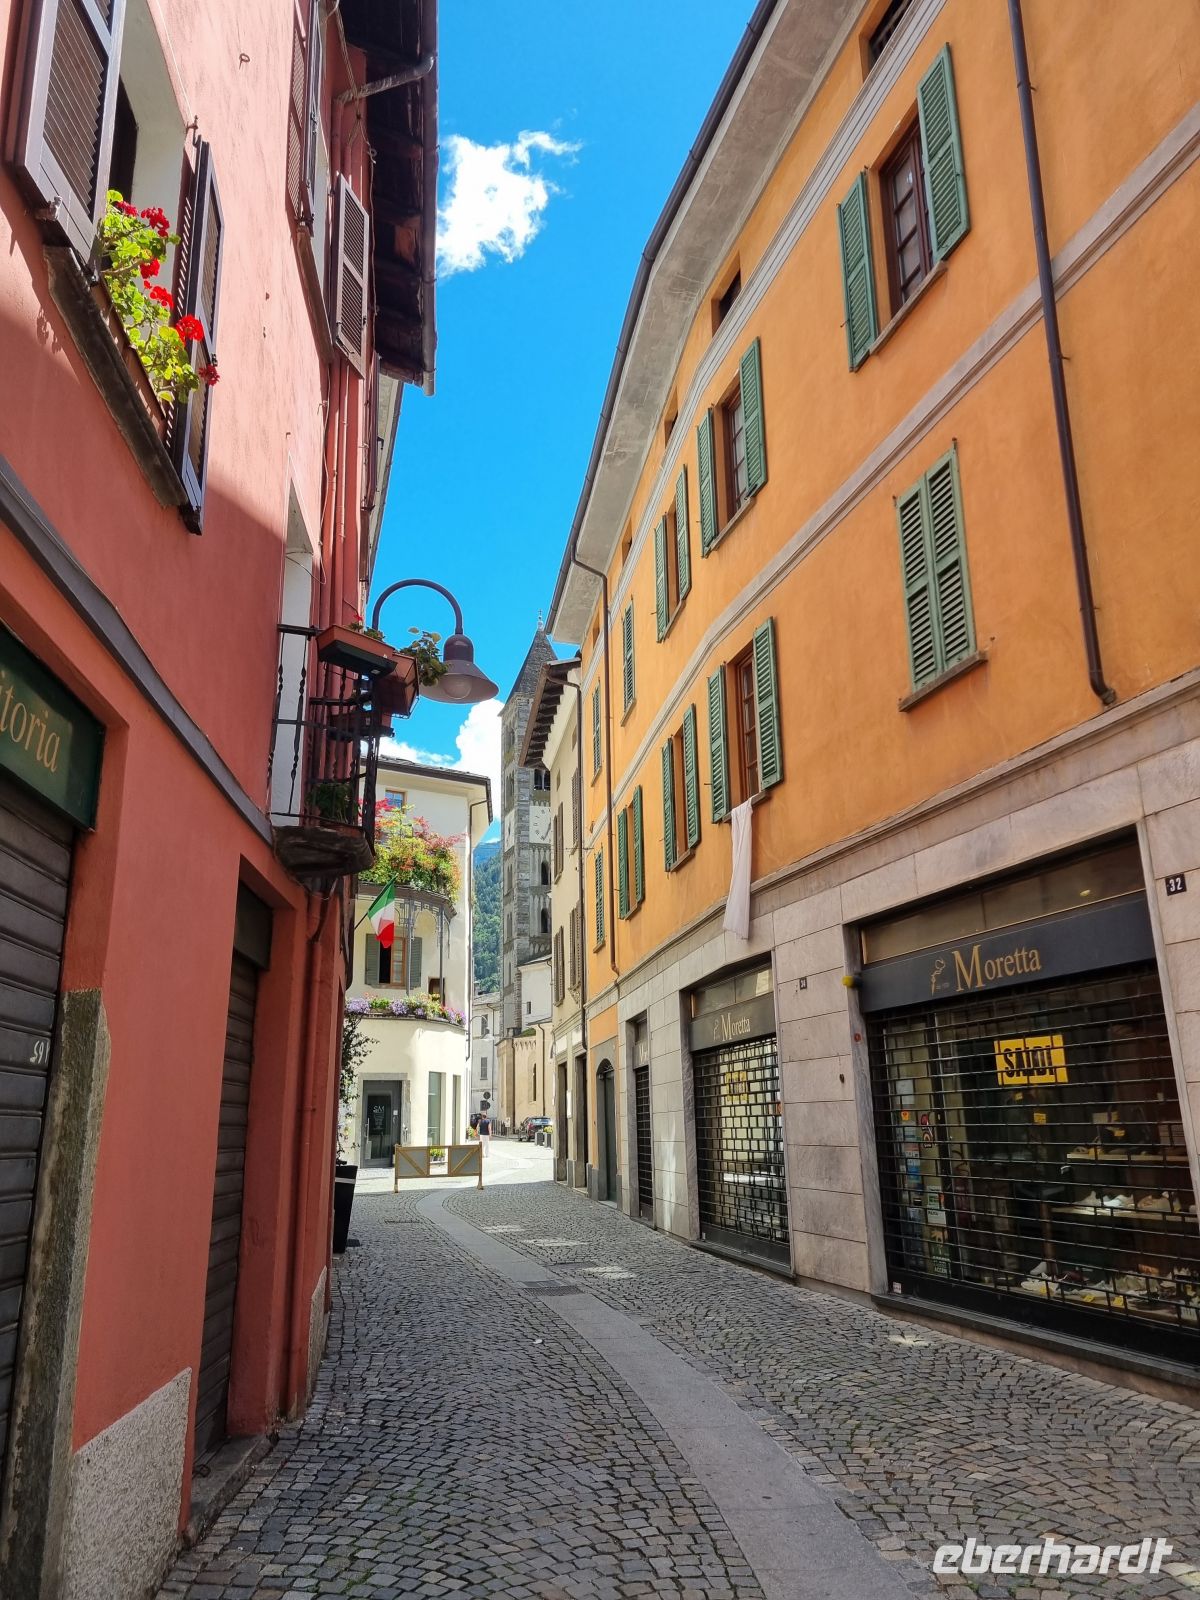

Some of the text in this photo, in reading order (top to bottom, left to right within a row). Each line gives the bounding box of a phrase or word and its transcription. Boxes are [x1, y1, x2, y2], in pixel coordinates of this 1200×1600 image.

[1169, 877, 1183, 892] 32
[951, 944, 1042, 992] Moretta
[720, 1012, 751, 1042] Moretta
[1003, 1045, 1055, 1078] SALDI
